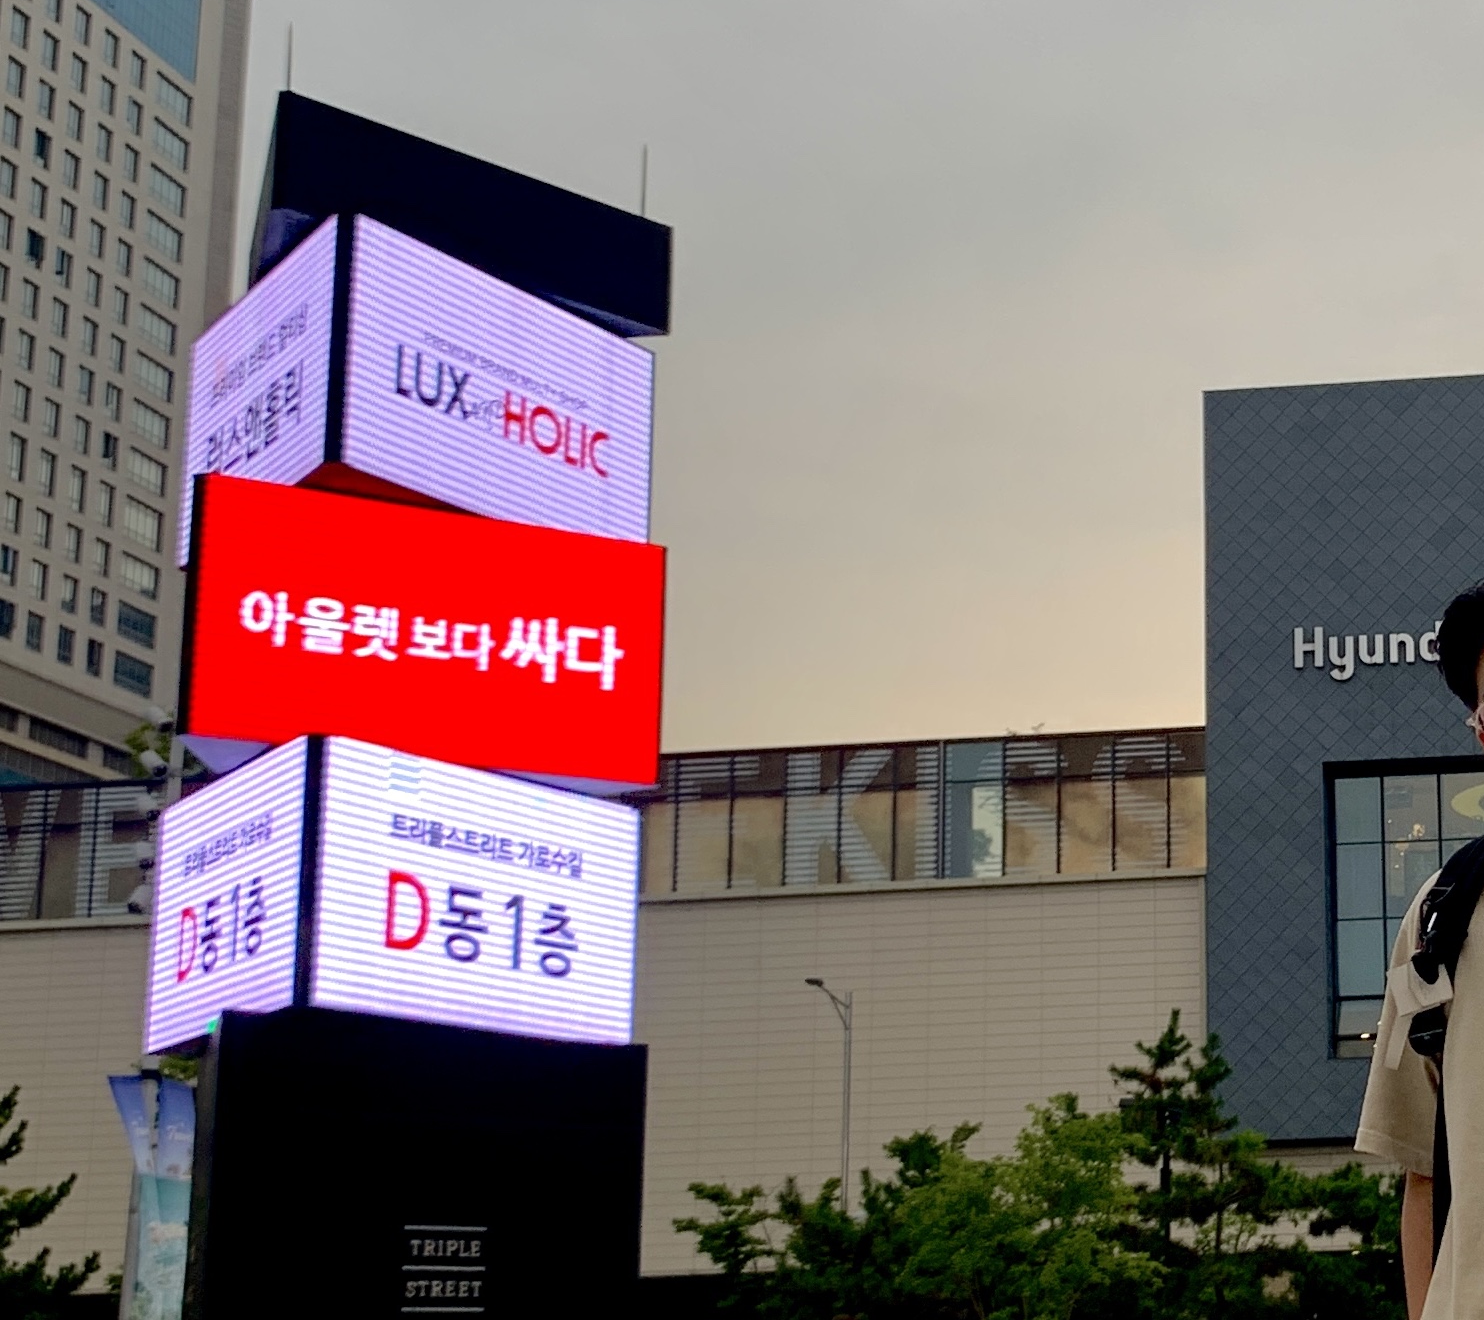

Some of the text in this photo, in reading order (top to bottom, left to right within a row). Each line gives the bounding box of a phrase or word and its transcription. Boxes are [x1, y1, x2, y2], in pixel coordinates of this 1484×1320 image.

[396, 344, 471, 419] LUX
[504, 389, 609, 478] HOLIC
[239, 590, 625, 692] 아울렛 보다 싸다
[390, 813, 583, 878] 트리플스트리트 가로수길
[410, 1239, 482, 1257] TRIPLE
[405, 1280, 482, 1298] STREET
